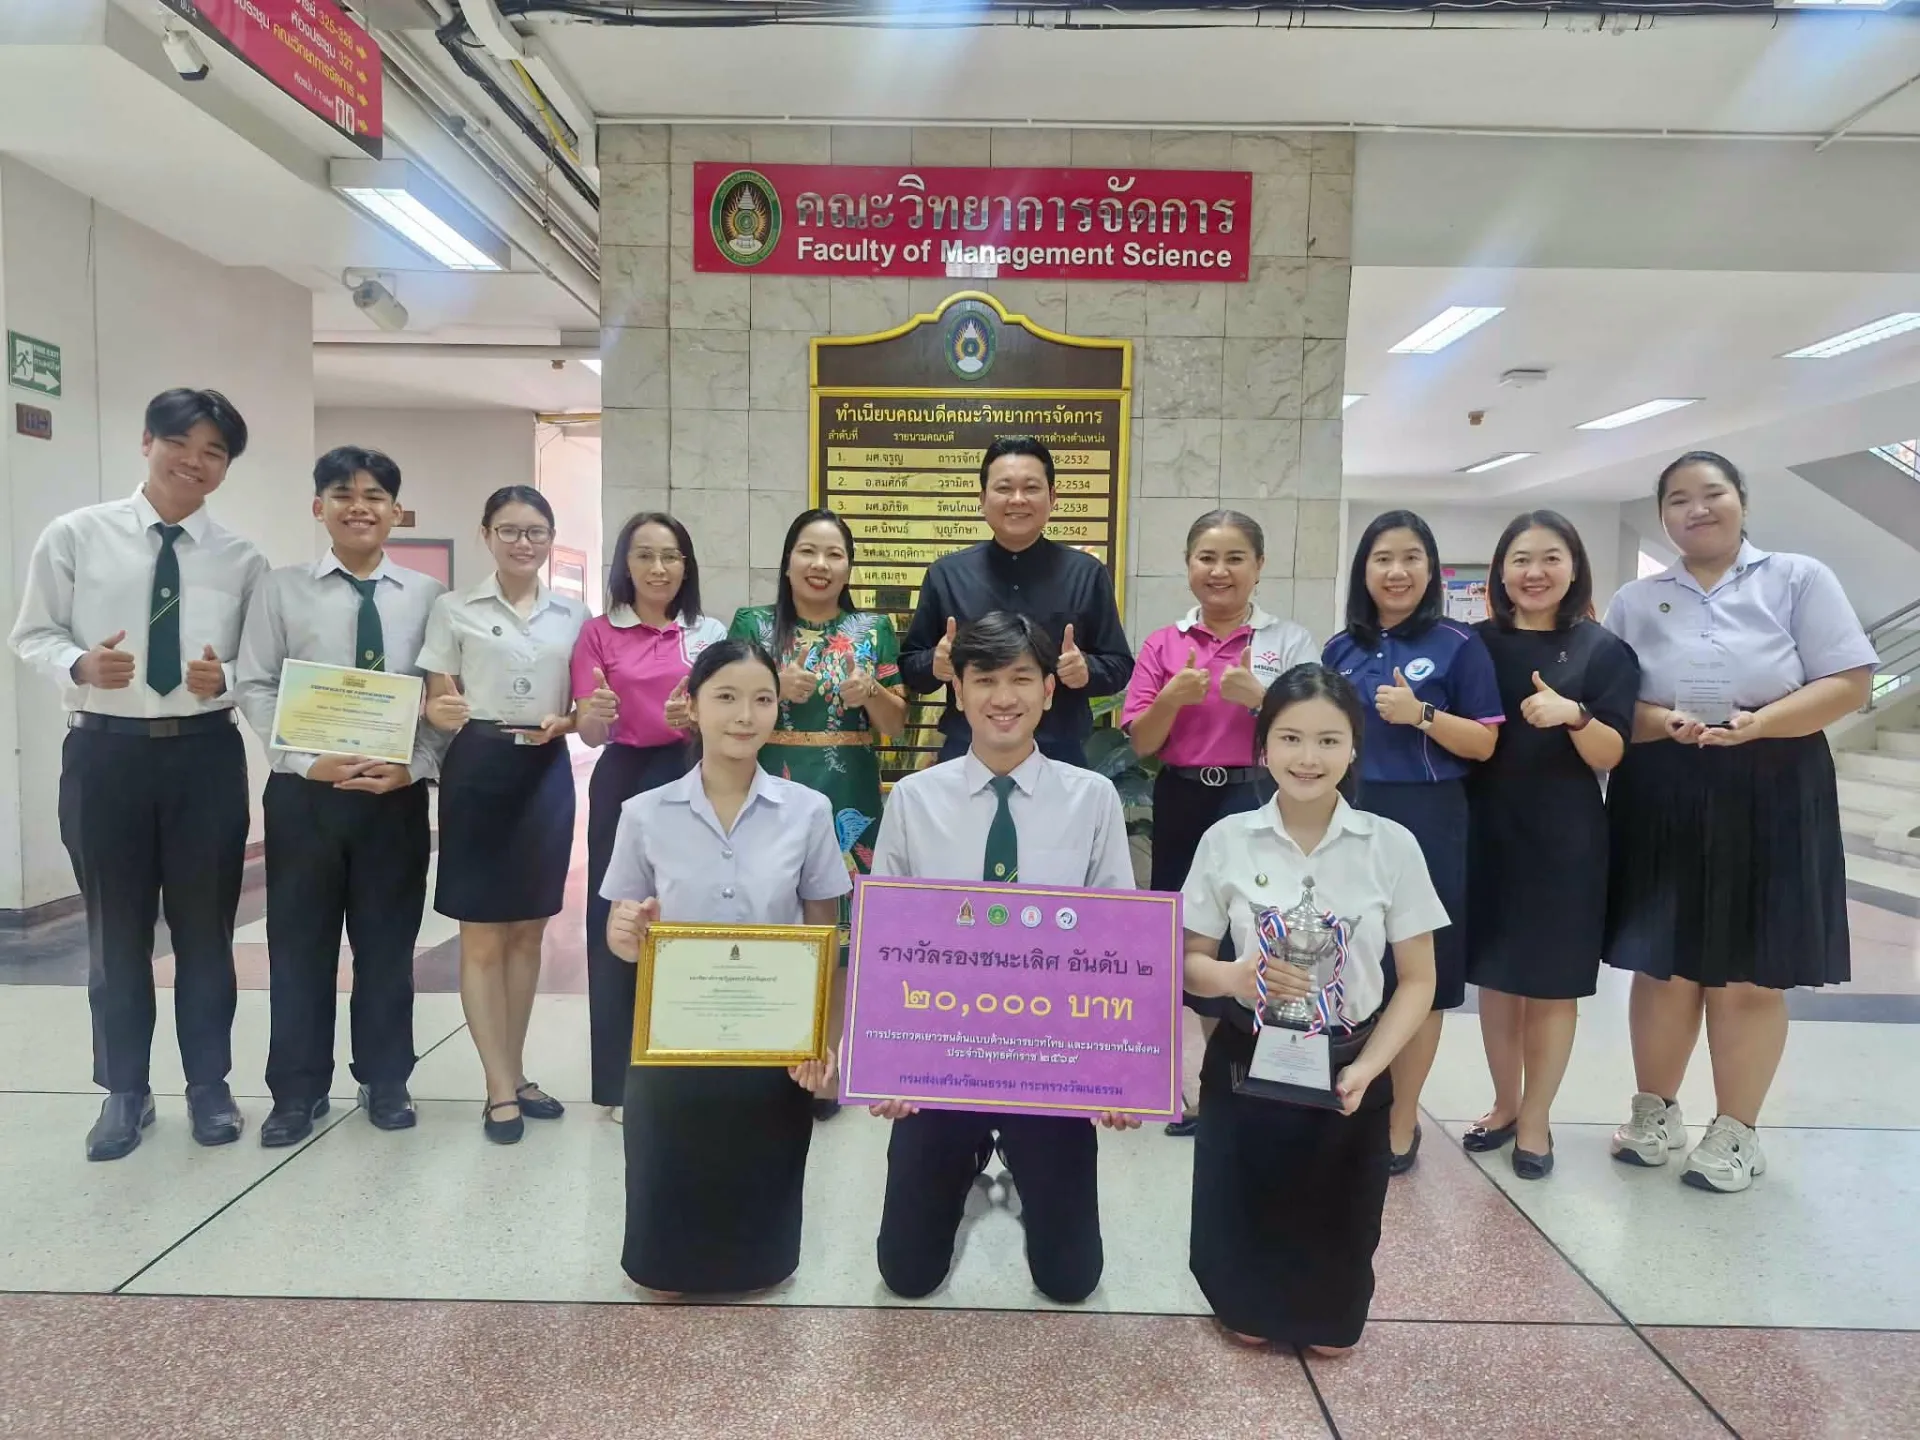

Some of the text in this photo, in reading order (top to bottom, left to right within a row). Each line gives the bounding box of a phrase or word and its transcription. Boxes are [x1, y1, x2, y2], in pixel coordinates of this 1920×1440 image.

[796, 173, 1236, 234] คณะวิทยาการจัดการ
[797, 236, 1232, 271] Faculty of Management Science
[836, 402, 1103, 424] ทำเนียบคณบดีคณะวิทยาการจัดการ
[878, 940, 1153, 976] รางวัลรองชนะเลิศ อันดับ ๒
[902, 980, 1133, 1020] ๒๐,๐๐๐ บาท
